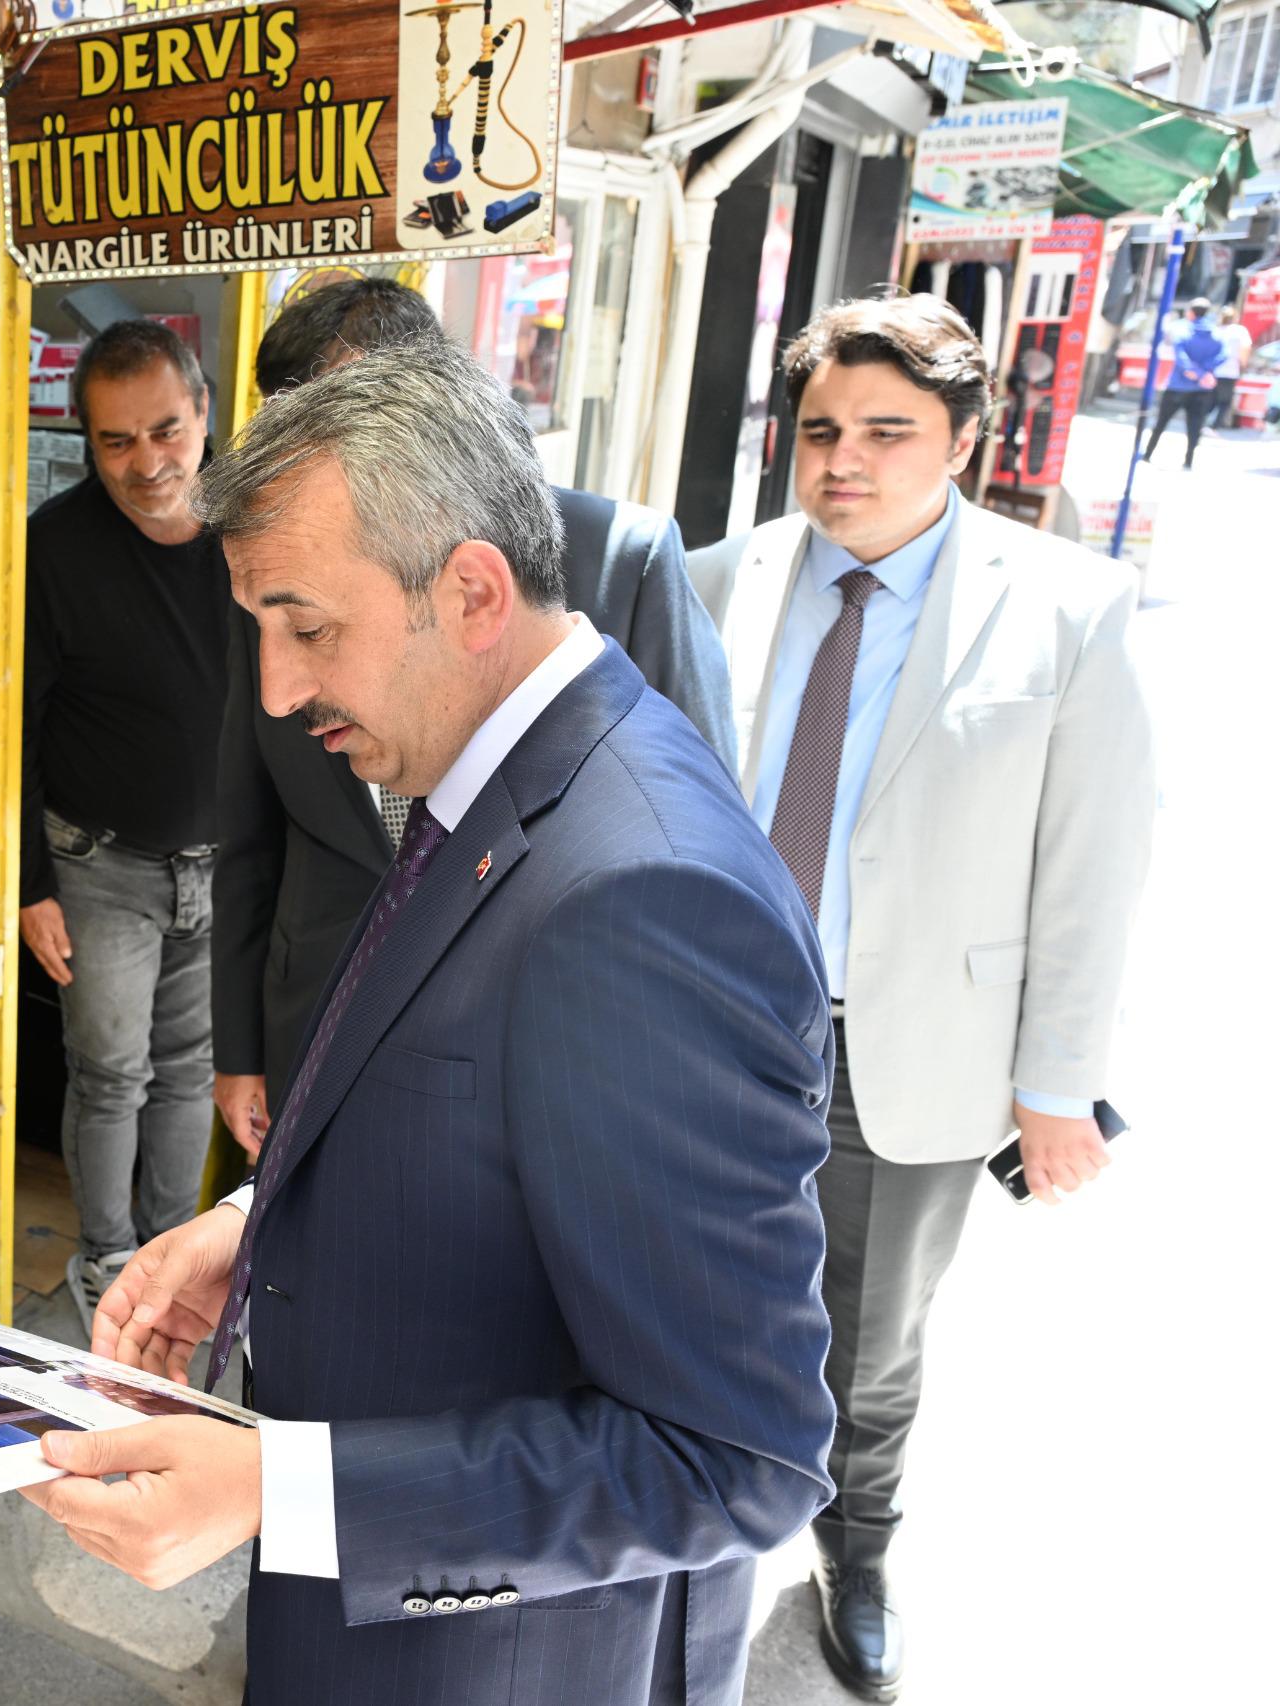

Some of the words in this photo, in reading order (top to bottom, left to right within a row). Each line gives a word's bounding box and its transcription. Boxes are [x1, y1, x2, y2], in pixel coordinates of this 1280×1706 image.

[79, 4, 299, 98] DERVİŞ
[9, 79, 391, 228] TÜTÜNCÜLÜK
[25, 226, 170, 273] NARGİLE
[182, 205, 373, 263] ÜRÜNLERİ
